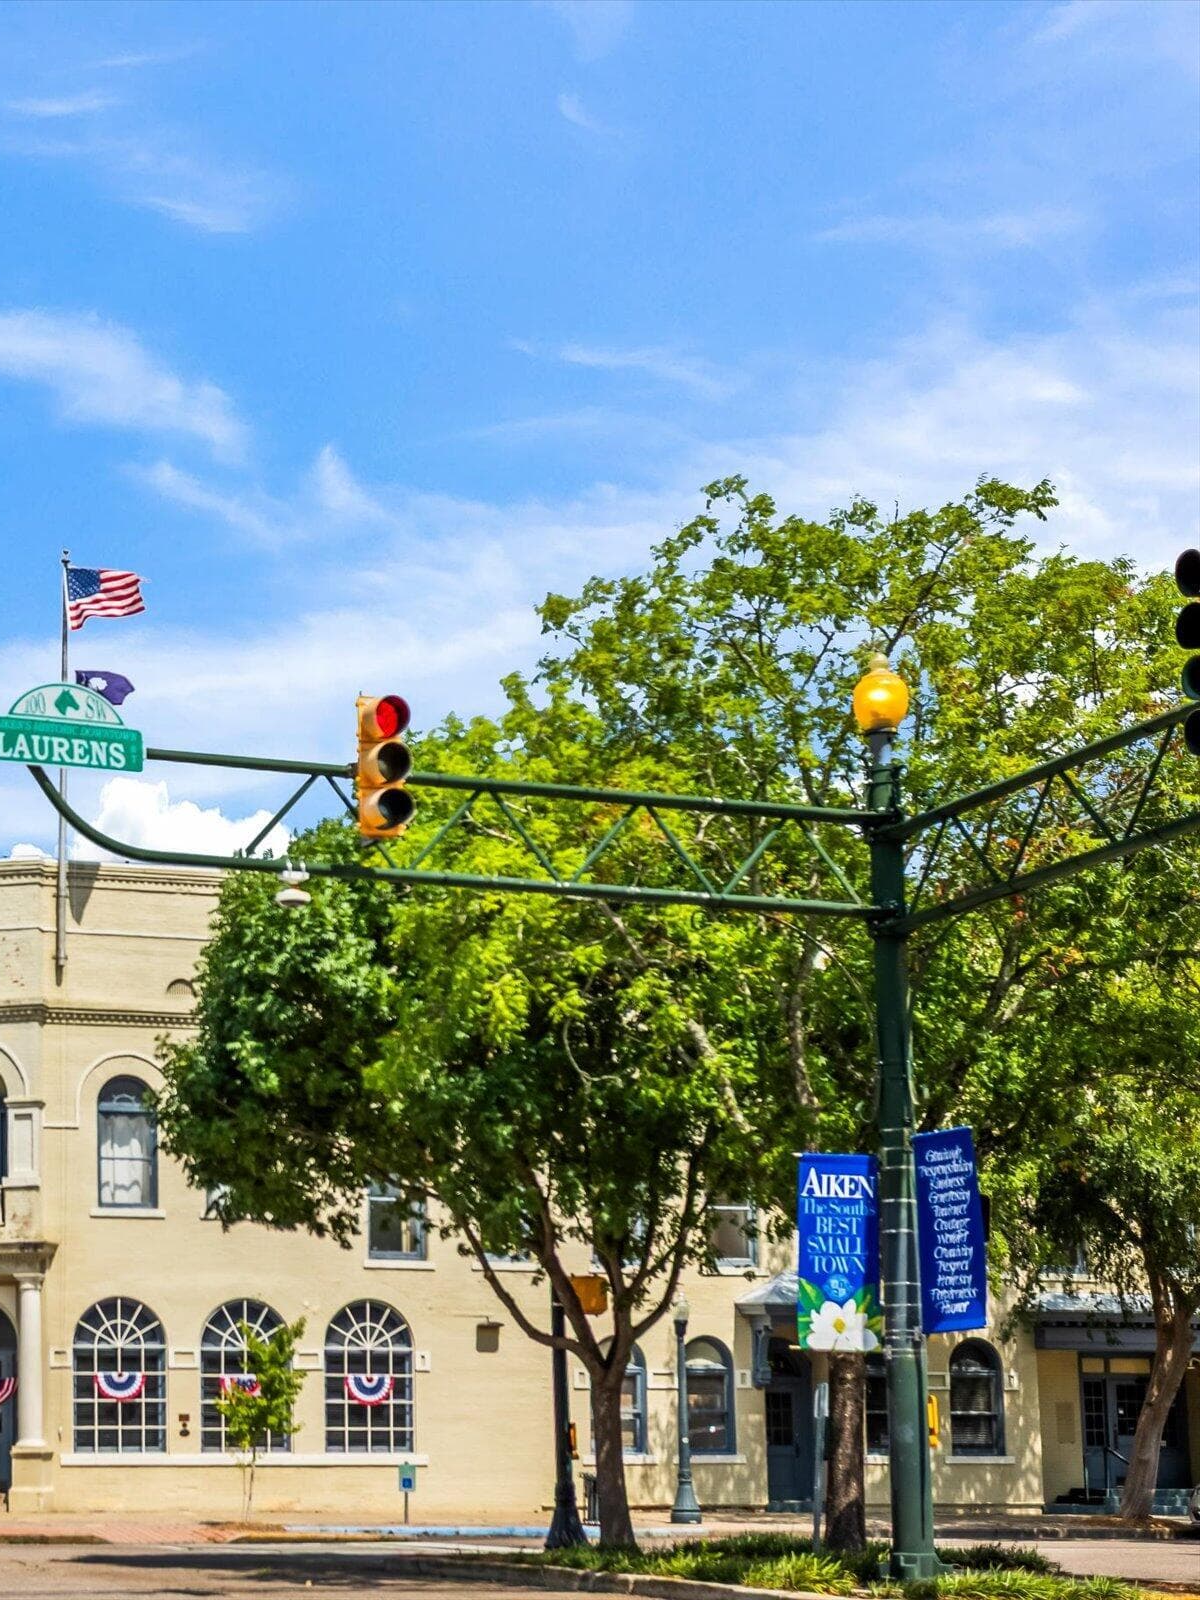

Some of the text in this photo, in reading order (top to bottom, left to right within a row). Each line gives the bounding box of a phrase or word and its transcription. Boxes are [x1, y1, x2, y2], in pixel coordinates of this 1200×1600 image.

[25, 693, 107, 721] 100 SW
[800, 1167, 875, 1199] AIKEN
[801, 1198, 827, 1215] The
[816, 1216, 862, 1235] BEST
[807, 1235, 869, 1255] SMALL
[809, 1255, 866, 1274] TOWN
